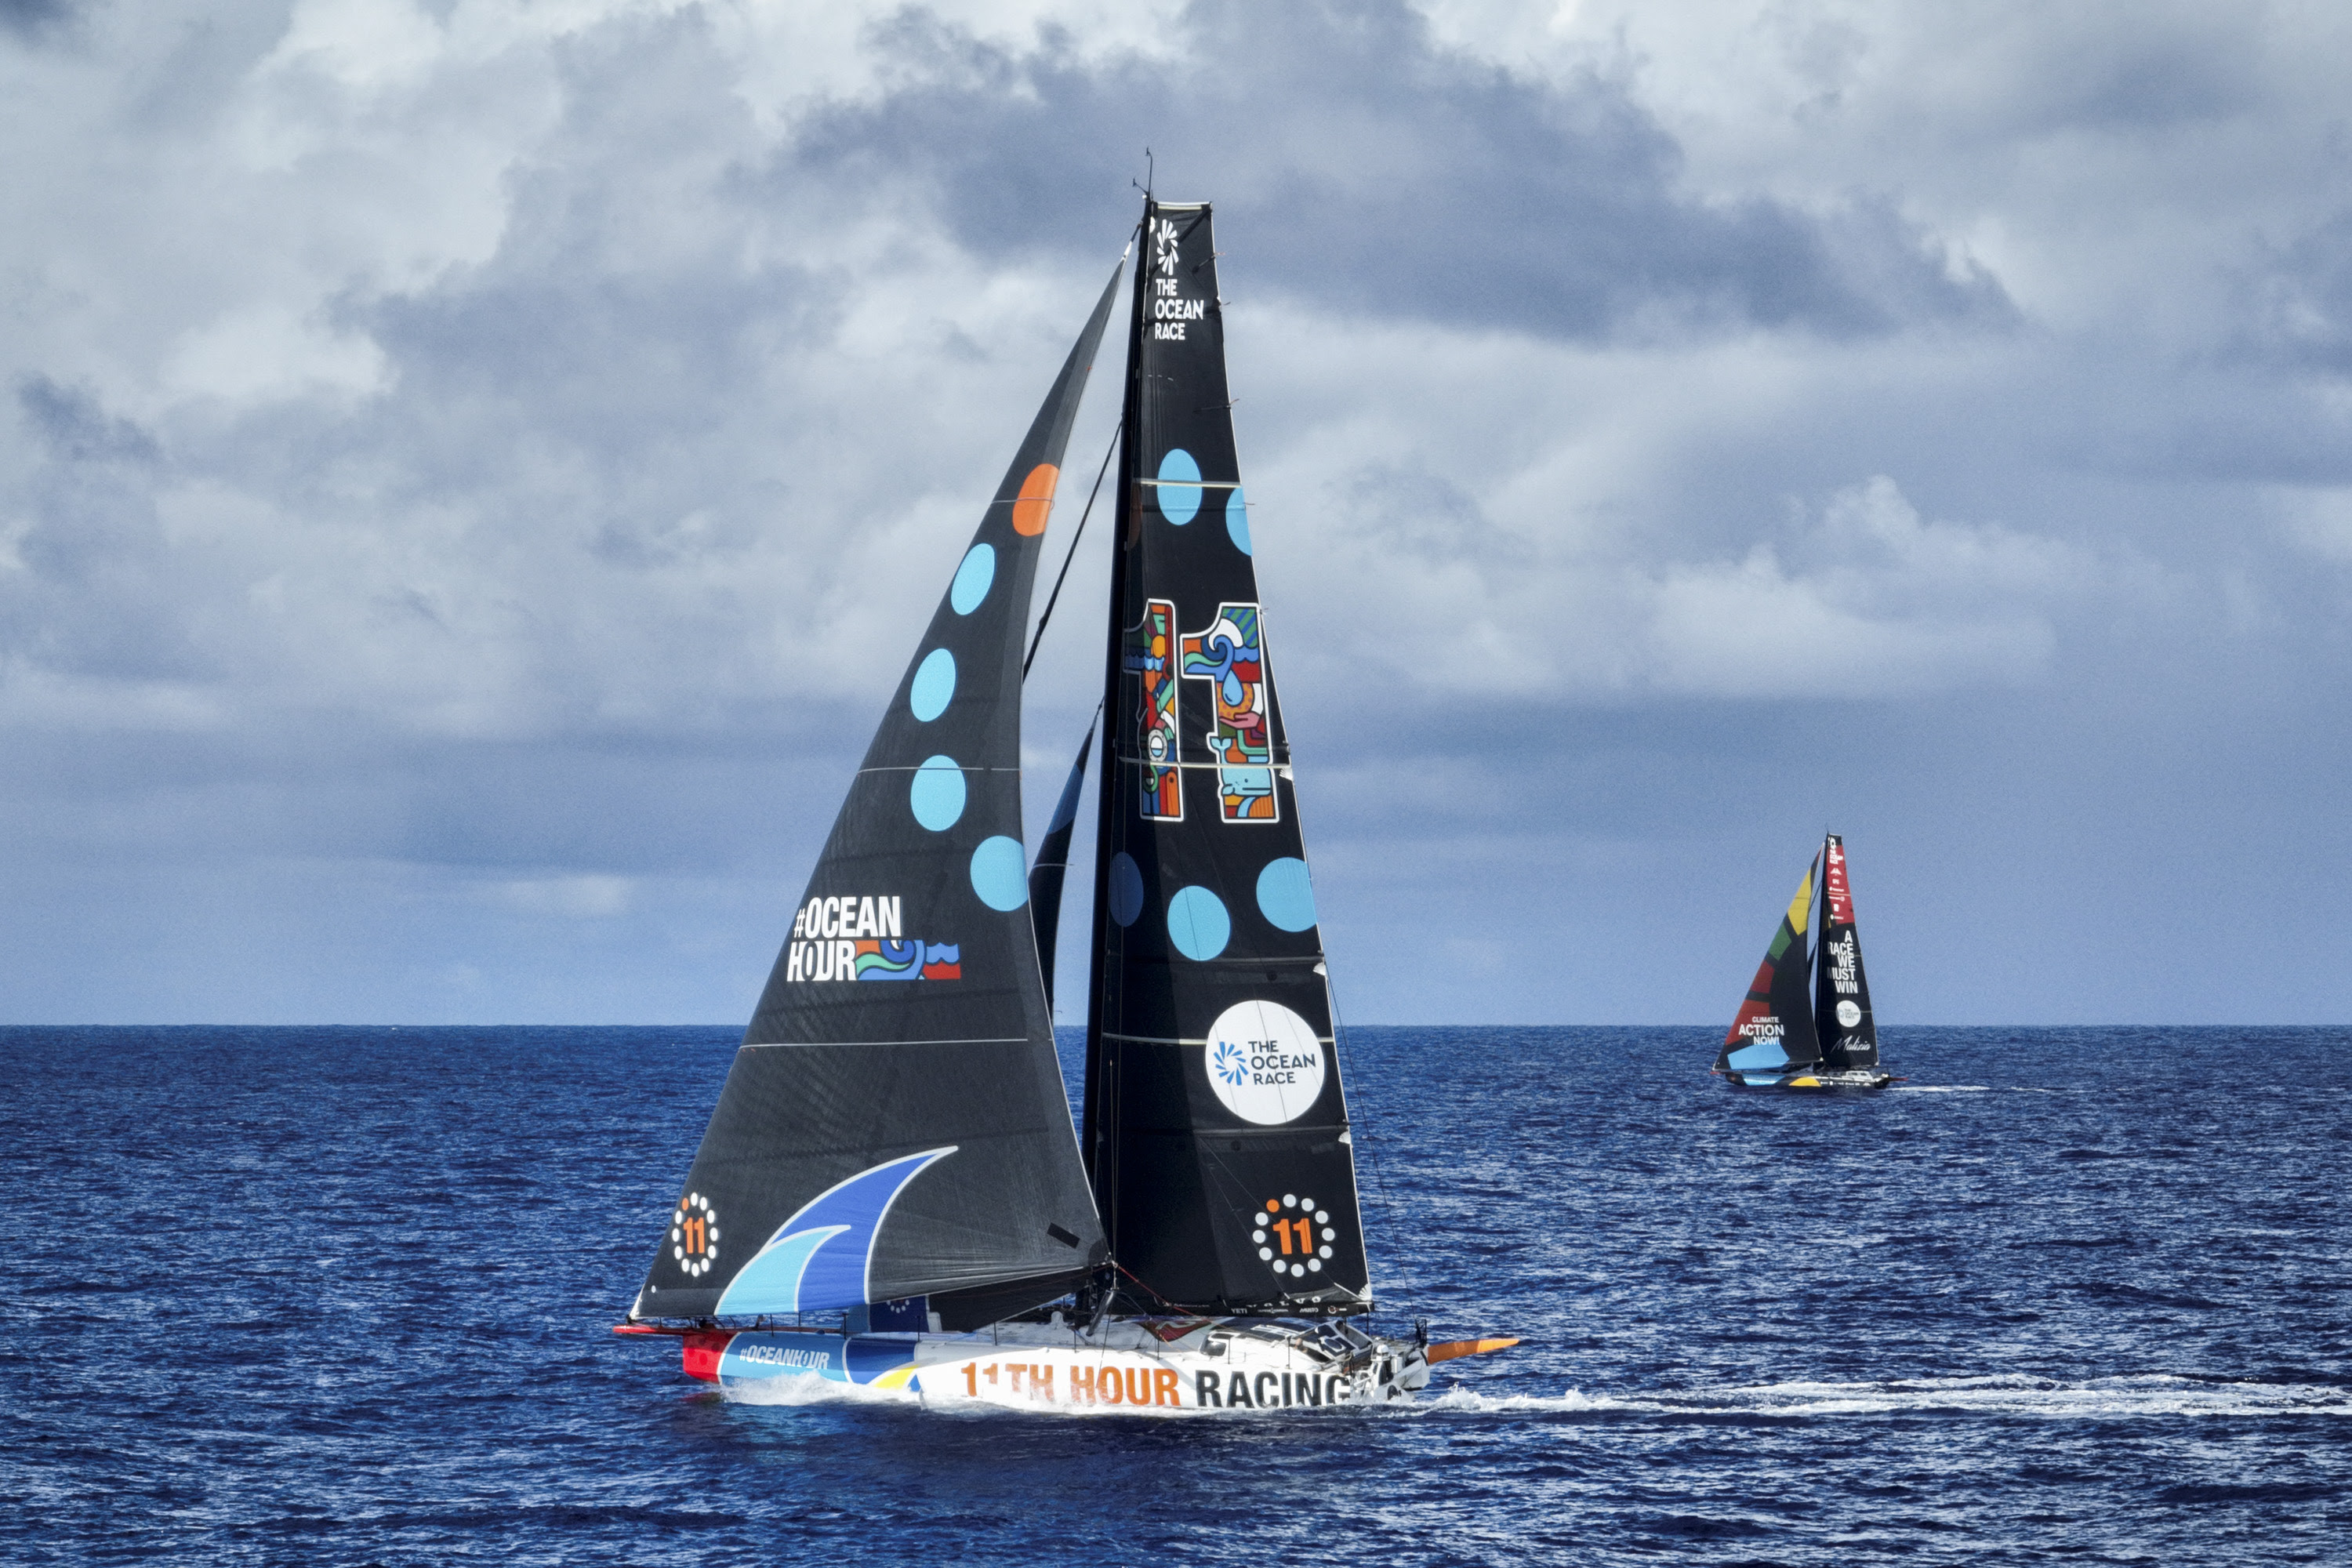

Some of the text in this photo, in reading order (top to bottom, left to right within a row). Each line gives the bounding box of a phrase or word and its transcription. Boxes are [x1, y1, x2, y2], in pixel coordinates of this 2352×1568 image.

[1156, 278, 1178, 296] THE
[1155, 299, 1204, 320] OCEAN
[1154, 322, 1185, 340] RACE
[793, 895, 902, 938] #OCEAN
[1844, 930, 1853, 943] A
[1828, 942, 1854, 956] RACE
[786, 939, 858, 982] HOUR
[1837, 955, 1856, 968] WE
[1827, 967, 1856, 981] MUST
[1835, 980, 1858, 993] WIN
[1738, 1023, 1785, 1036] ACTION
[1248, 1040, 1279, 1053] THE
[1753, 1036, 1780, 1046] NOW!
[1250, 1054, 1316, 1070] OCEAN
[1253, 1072, 1296, 1085] RACE
[683, 1217, 705, 1254] 11
[1272, 1218, 1312, 1254] 11
[960, 1362, 1351, 1408] 11TH HOUR RACING
